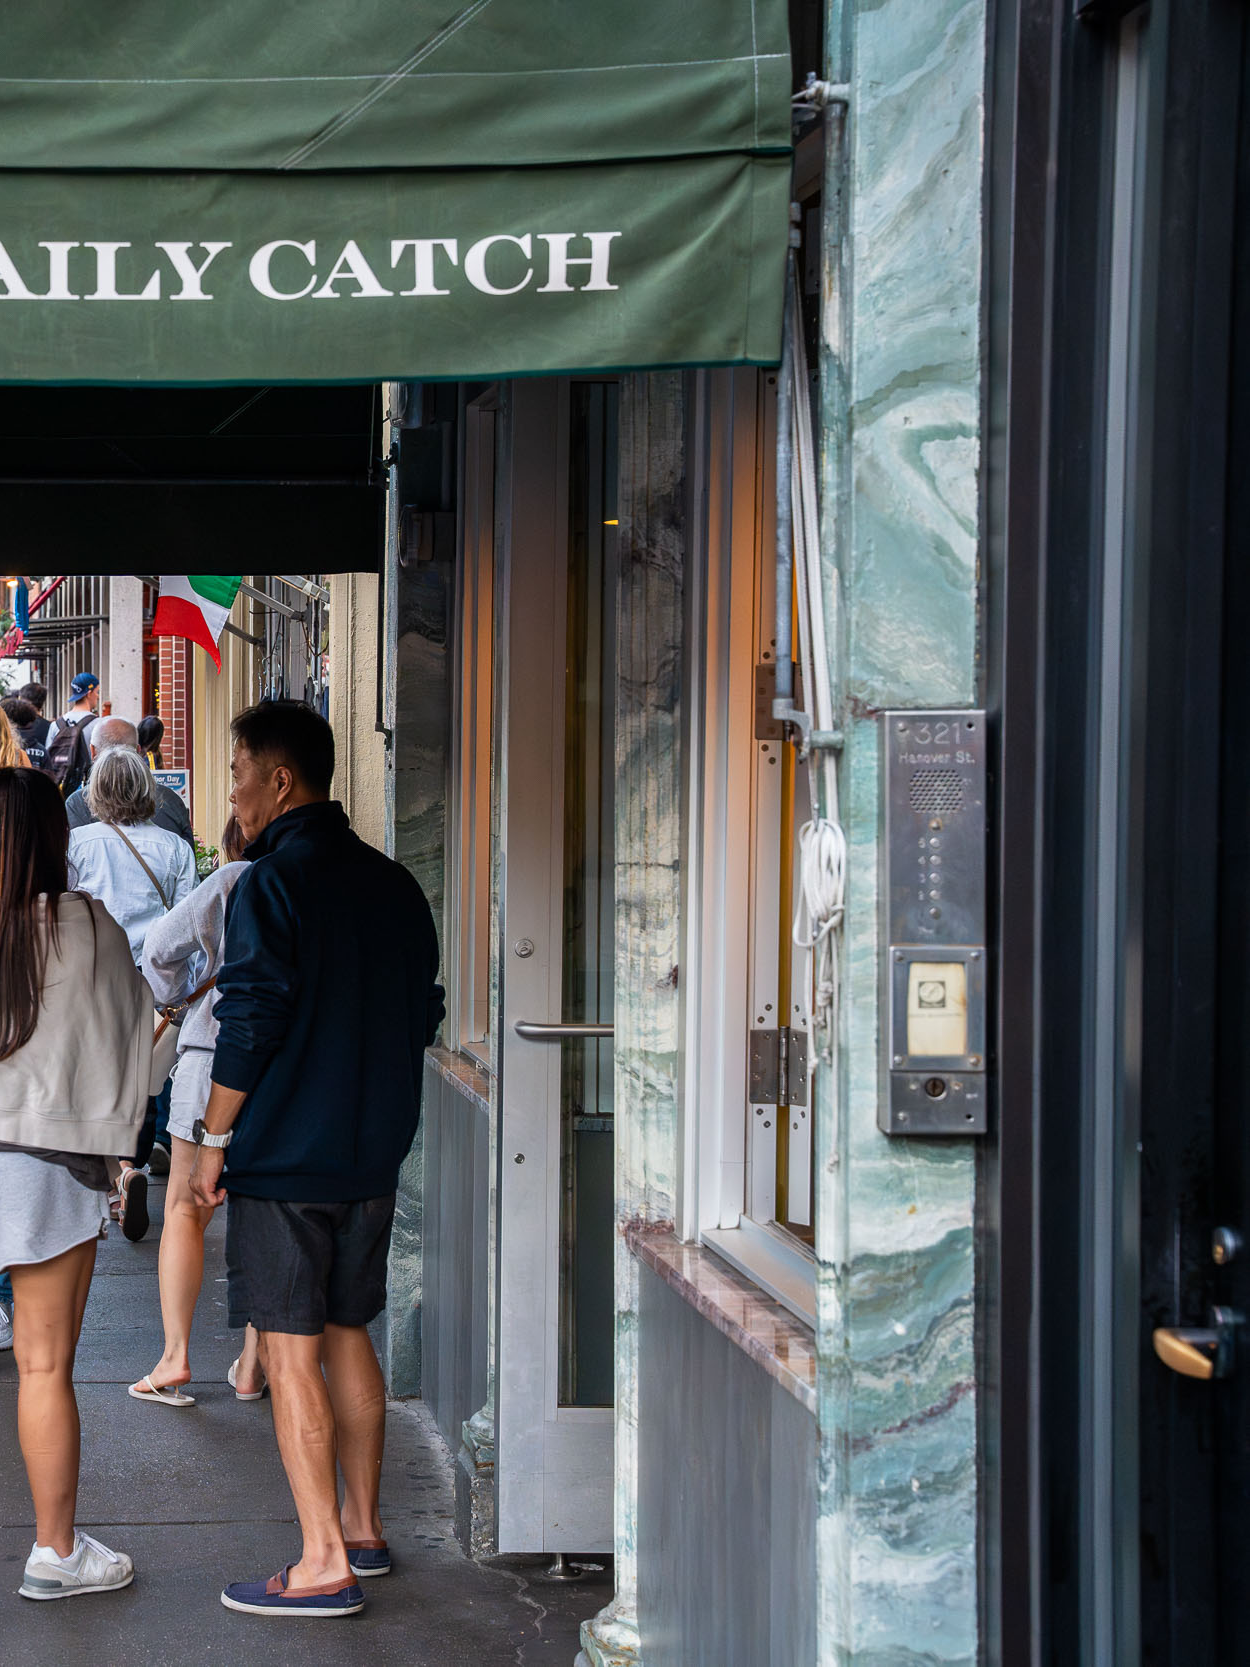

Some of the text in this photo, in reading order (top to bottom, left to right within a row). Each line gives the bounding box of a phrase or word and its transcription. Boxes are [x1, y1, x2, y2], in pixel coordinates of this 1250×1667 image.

[249, 232, 622, 301] CATCH
[914, 722, 961, 745] 321
[25, 748, 45, 757] NTED
[898, 750, 976, 764] Hanover St.
[166, 775, 180, 784] Day
